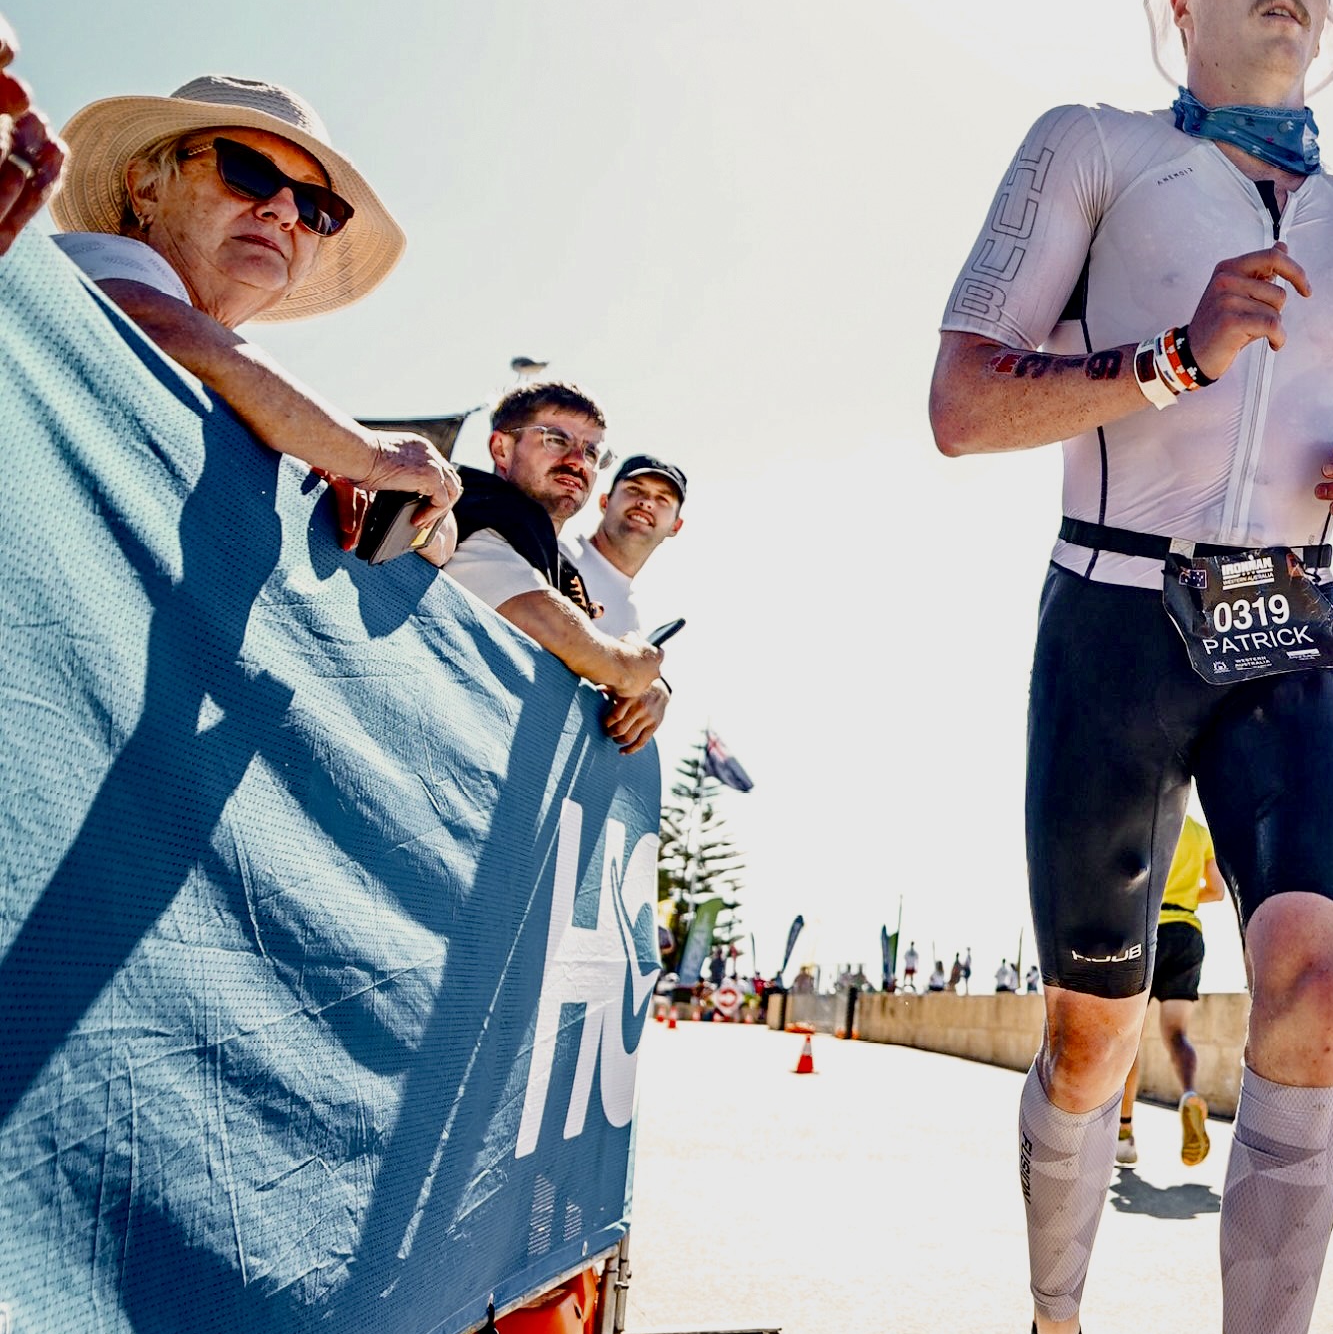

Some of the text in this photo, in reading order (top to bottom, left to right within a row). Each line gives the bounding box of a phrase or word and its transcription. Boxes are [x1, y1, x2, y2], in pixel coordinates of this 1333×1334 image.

[1221, 554, 1274, 576] IRONMAN
[1213, 594, 1290, 633] 0319
[1202, 625, 1314, 655] PATRICK
